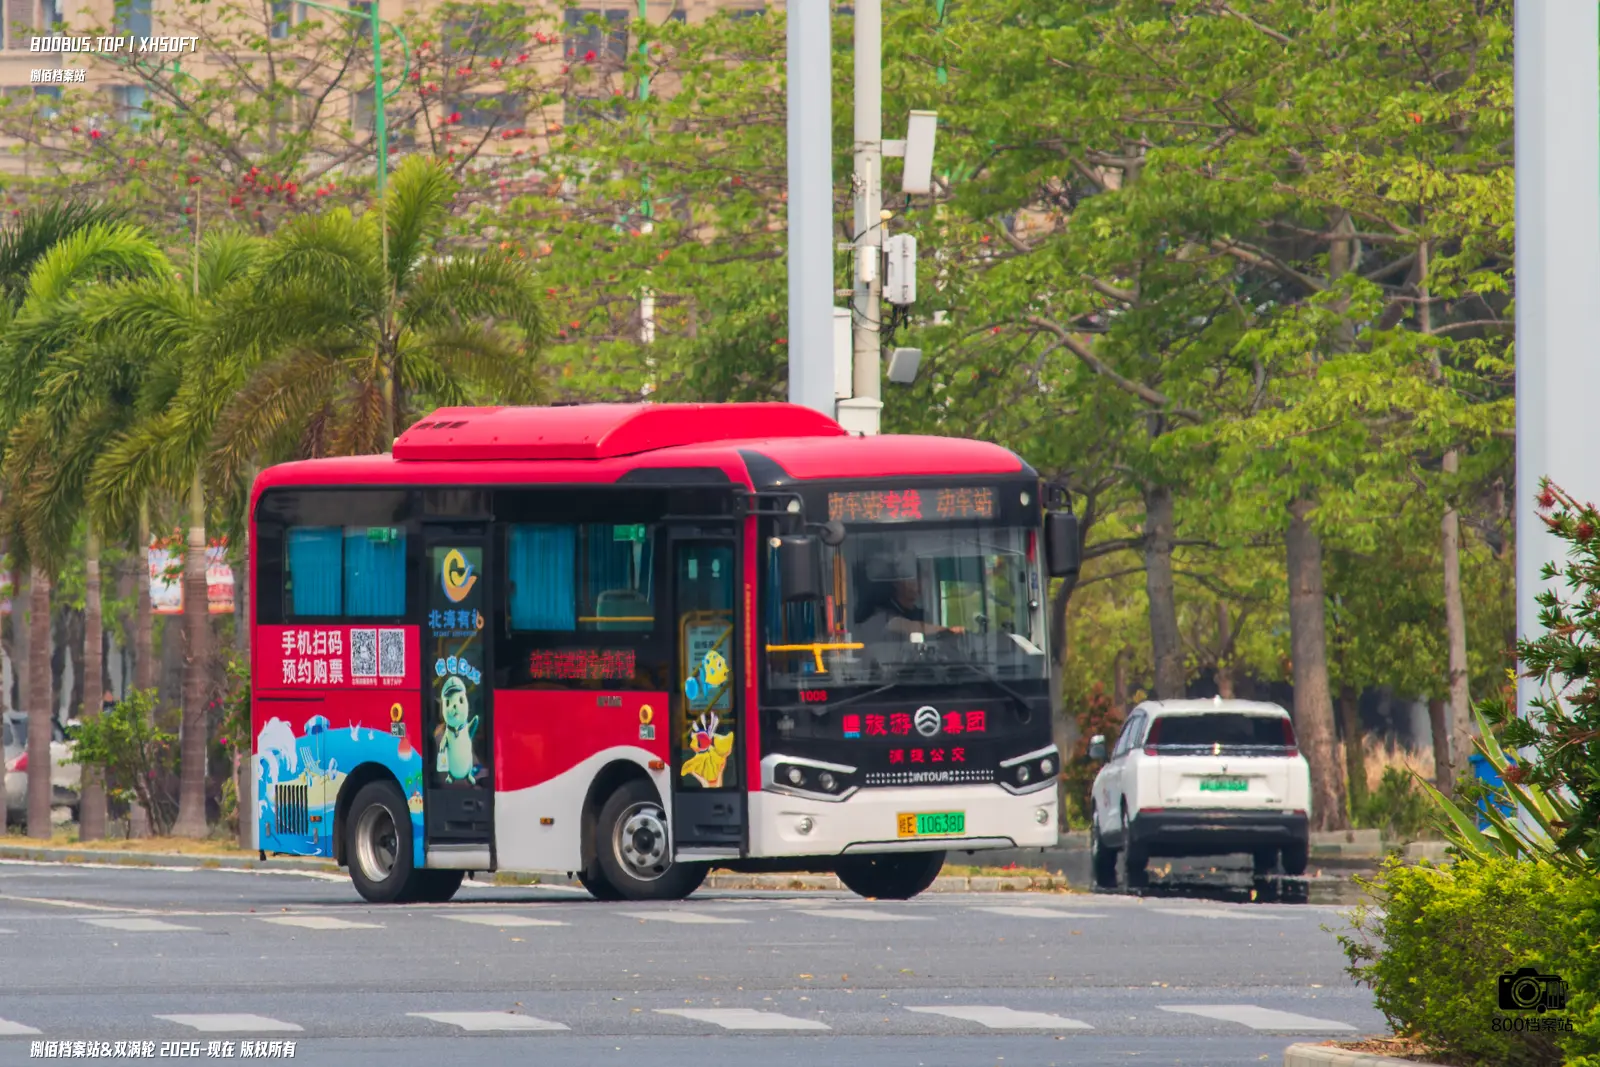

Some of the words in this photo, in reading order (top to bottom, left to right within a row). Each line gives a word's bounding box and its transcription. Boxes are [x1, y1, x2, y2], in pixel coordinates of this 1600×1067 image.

[281, 629, 343, 655] 手机扫码
[281, 658, 344, 684] 预约购票
